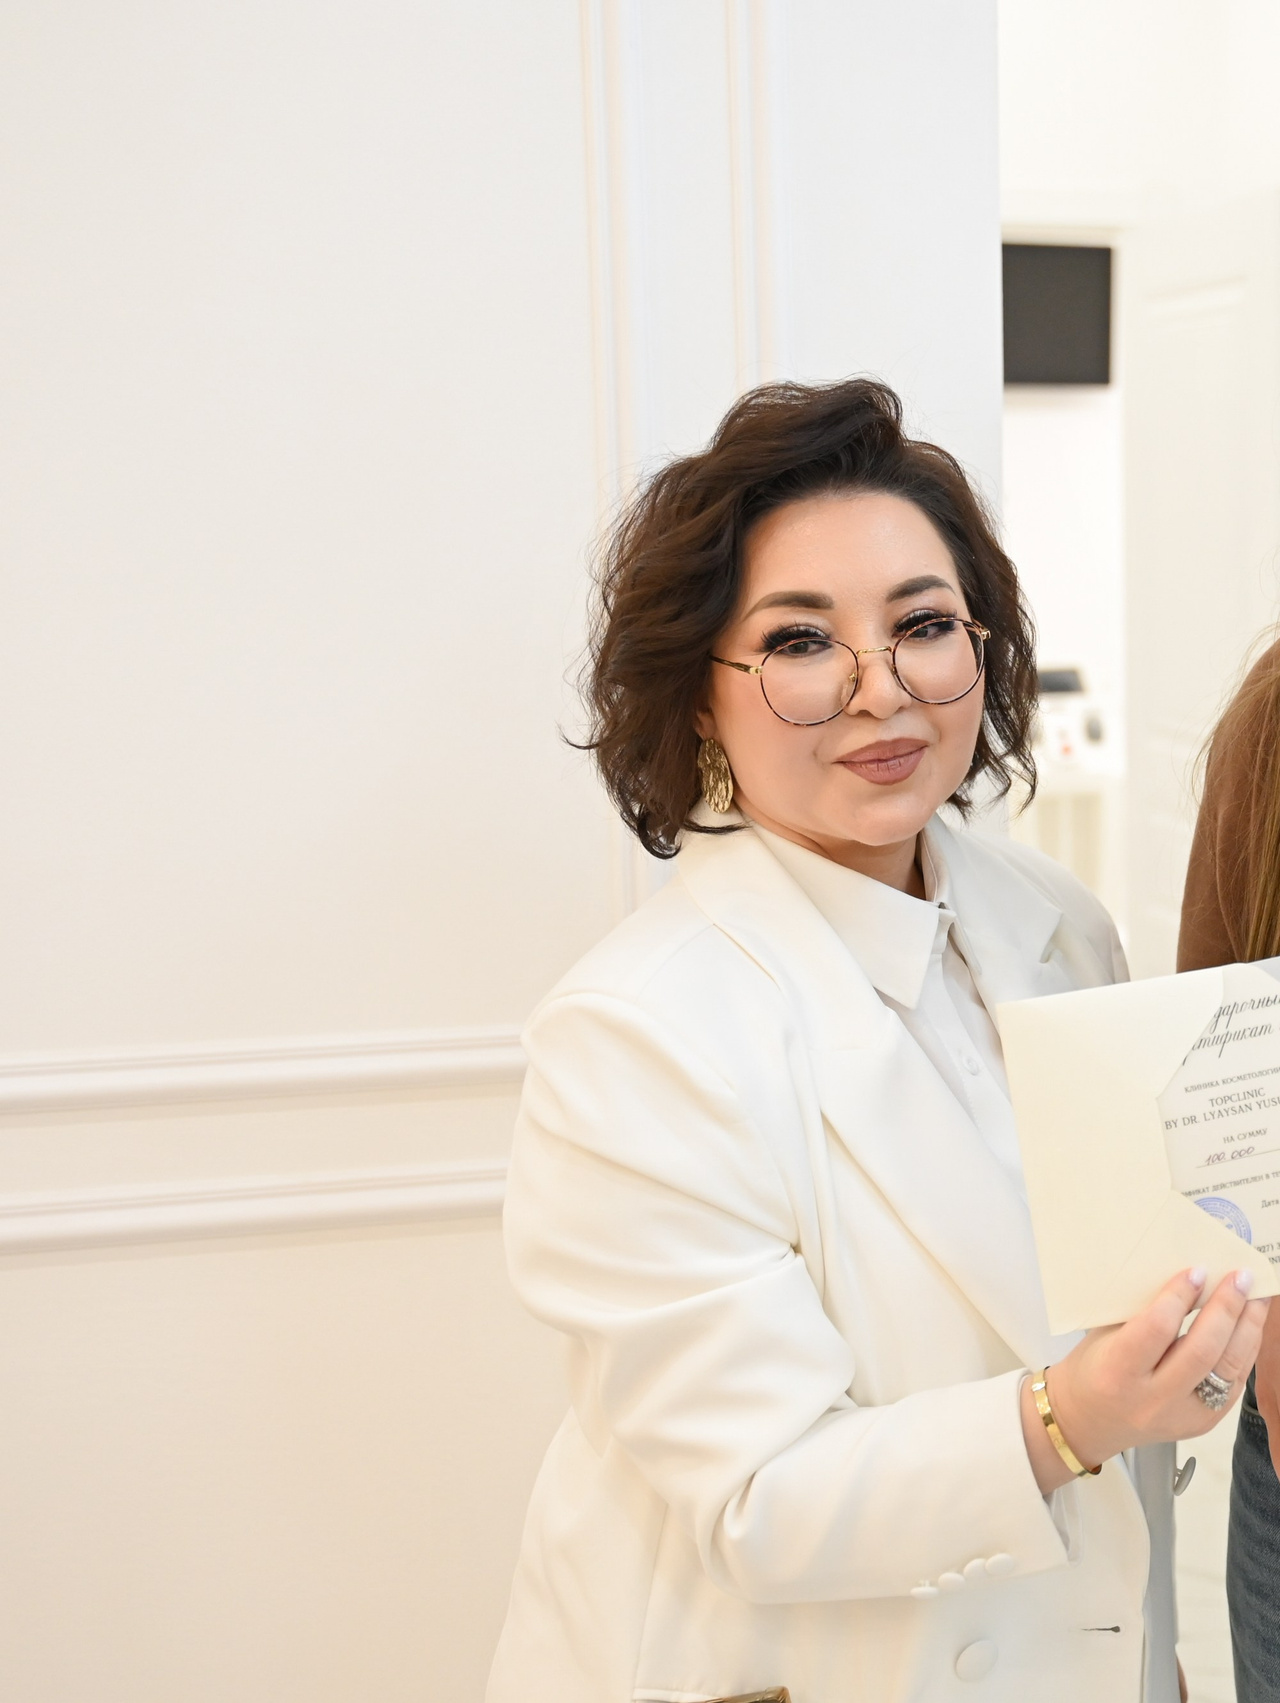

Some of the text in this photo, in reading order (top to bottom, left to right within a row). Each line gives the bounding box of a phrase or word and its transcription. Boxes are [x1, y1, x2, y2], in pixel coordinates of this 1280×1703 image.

[1182, 1023, 1274, 1066] тификат
[1184, 1080, 1220, 1094] КЛИНИКА
[1208, 1087, 1266, 1108] TOPCLINIC
[1164, 1118, 1179, 1130] BY
[1182, 1115, 1200, 1127] DR.
[1203, 1102, 1253, 1121] LYAYSAN
[1223, 1128, 1268, 1144] НА СУММУ
[1211, 1174, 1264, 1192] ДЕЙСТВИТЕЛЕН
[1261, 1199, 1280, 1209] Дата
